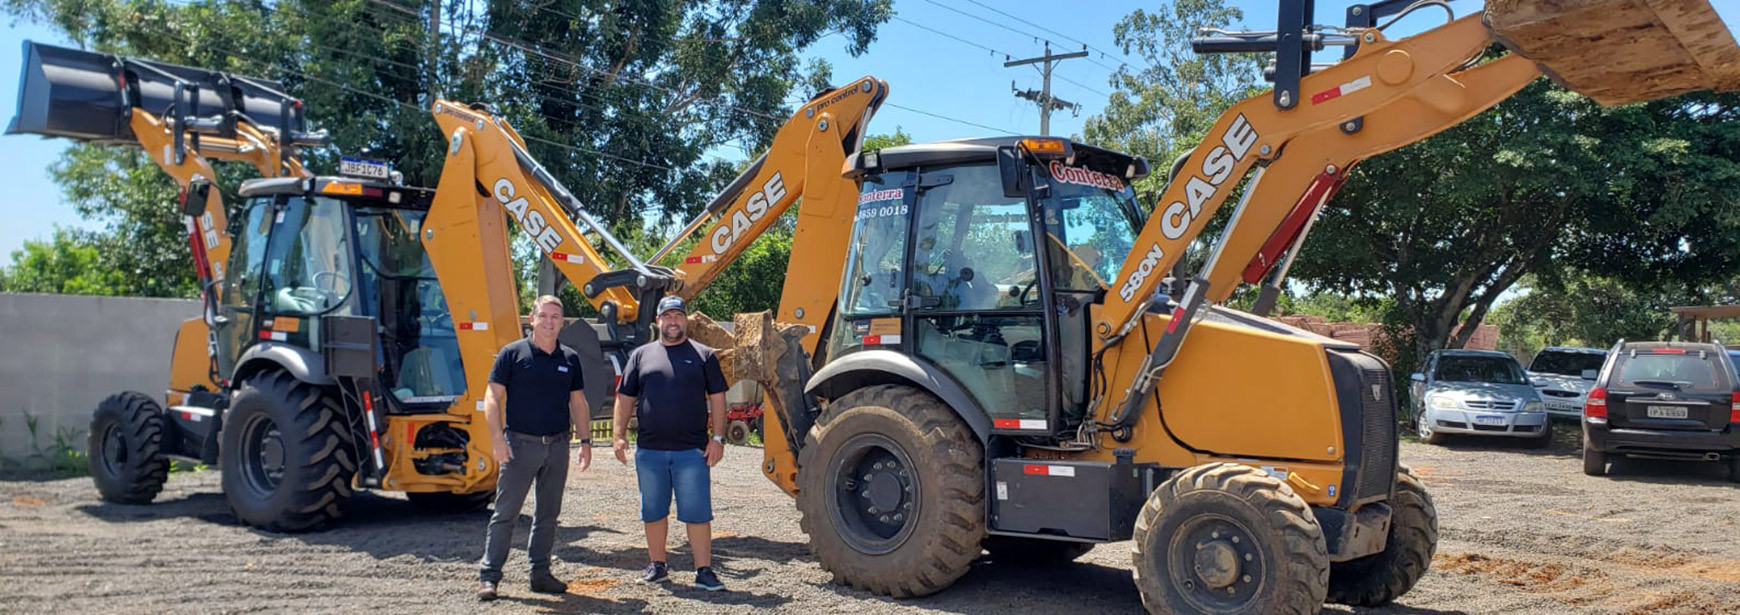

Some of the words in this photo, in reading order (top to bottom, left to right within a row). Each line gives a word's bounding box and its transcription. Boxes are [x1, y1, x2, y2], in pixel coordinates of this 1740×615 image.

[816, 100, 830, 112] pro
[830, 84, 859, 104] control
[344, 162, 384, 176] JBF1C76
[1049, 160, 1126, 193] Conterra
[1159, 111, 1259, 240] CASE
[493, 178, 564, 254] CASE
[710, 168, 788, 256] CASE
[879, 204, 909, 217] 0018
[1118, 241, 1165, 303] 580N
